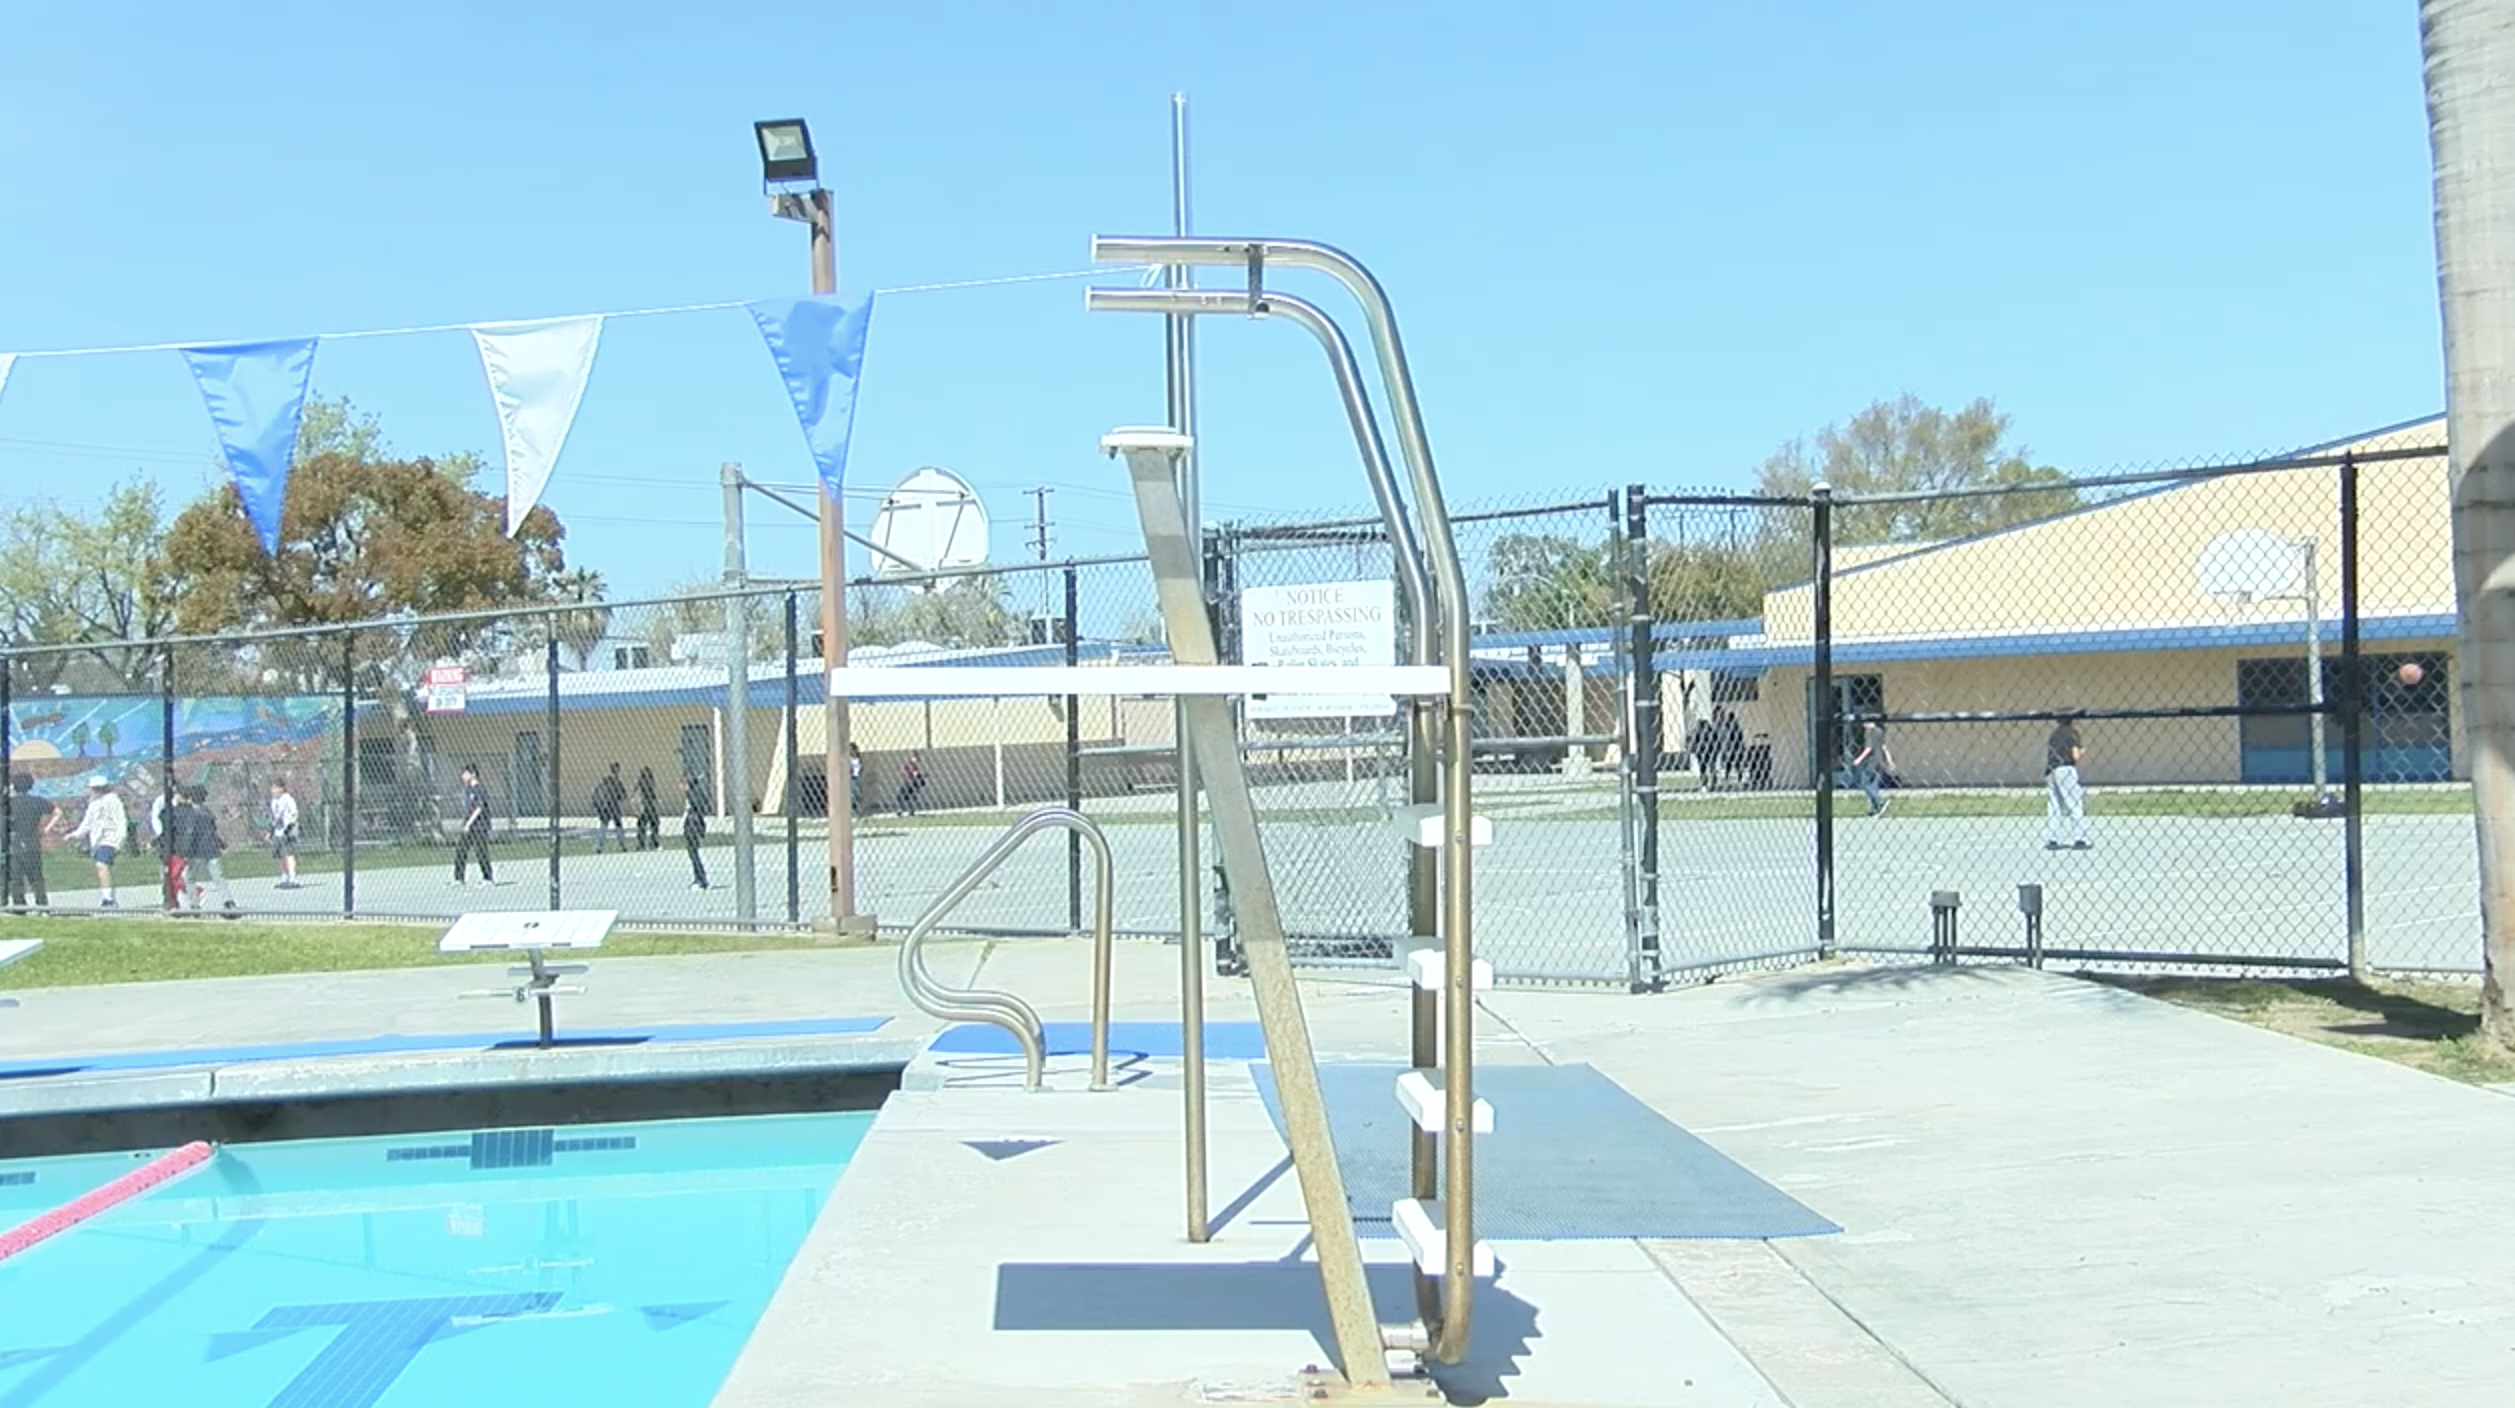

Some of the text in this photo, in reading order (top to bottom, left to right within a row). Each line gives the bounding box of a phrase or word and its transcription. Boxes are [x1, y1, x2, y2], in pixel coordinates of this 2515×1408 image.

[1286, 587, 1345, 606] NOTICE
[1253, 606, 1382, 627] NO TRESPASSING
[1269, 629, 1327, 643] Unauthorized
[516, 986, 525, 1003] 6
